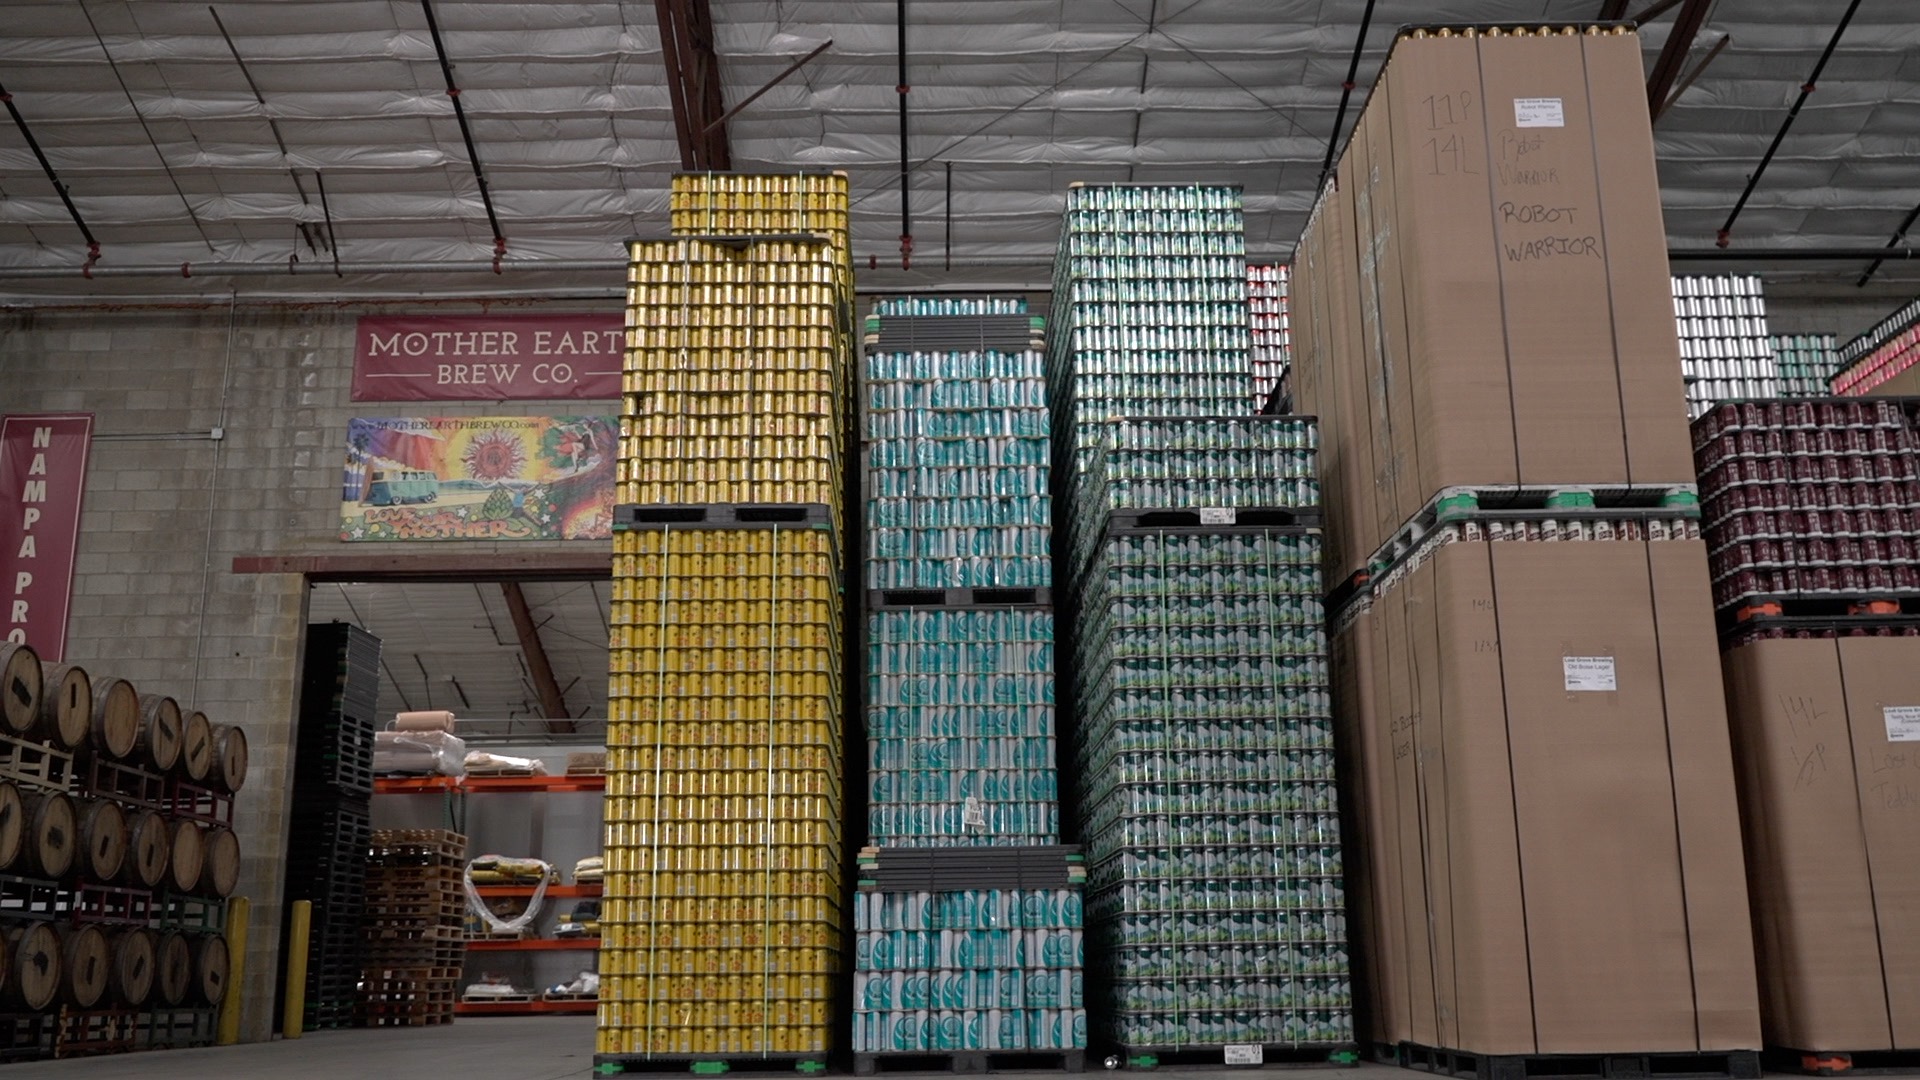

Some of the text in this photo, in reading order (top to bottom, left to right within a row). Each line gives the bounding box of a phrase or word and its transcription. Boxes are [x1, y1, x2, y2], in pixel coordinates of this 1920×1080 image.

[1422, 134, 1479, 175] 14L
[1499, 202, 1577, 224] ROBOT
[1504, 236, 1602, 262] WARRIOR
[368, 331, 623, 356] MOTHER EART
[437, 364, 578, 384] BREW CO.
[364, 507, 416, 524] LOVE
[8, 427, 52, 645] NAMPA PRO
[400, 519, 532, 538] MOTHER
